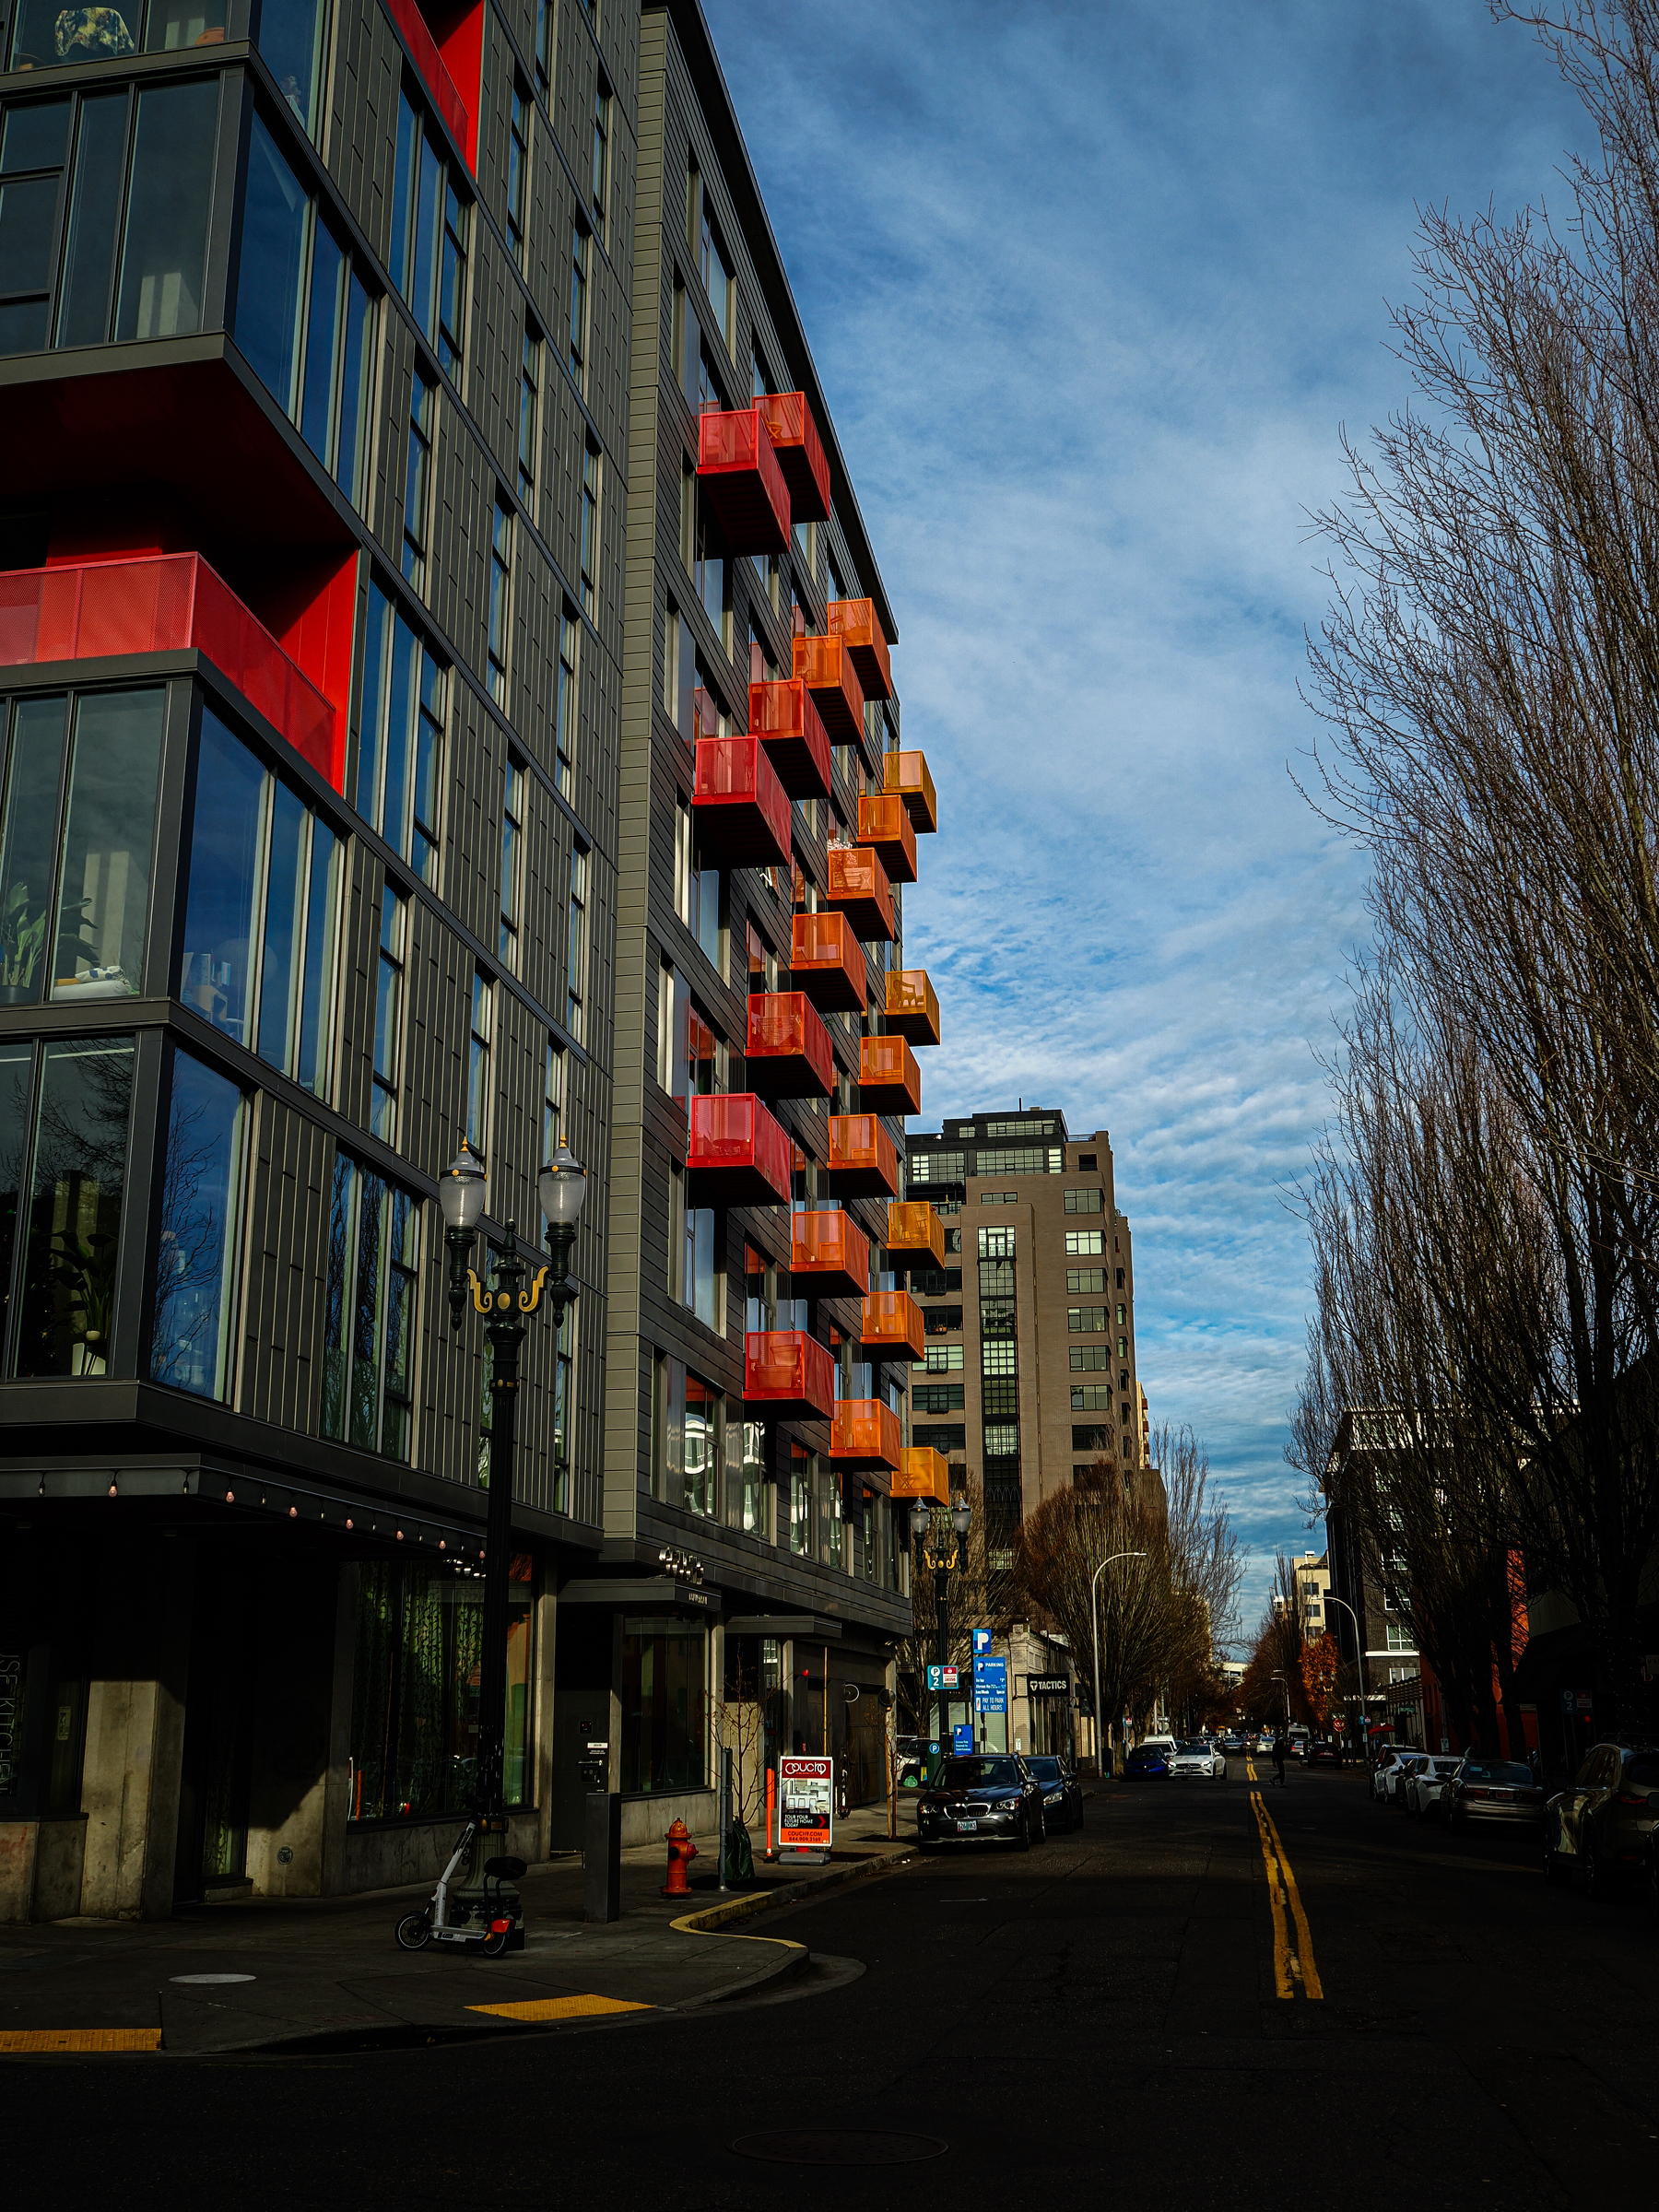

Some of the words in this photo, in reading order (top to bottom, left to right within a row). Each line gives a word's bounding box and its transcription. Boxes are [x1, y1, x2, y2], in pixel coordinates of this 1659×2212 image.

[977, 1633, 989, 1650] P
[933, 1677, 939, 1686] 2
[1038, 1680, 1067, 1690] TACTICS
[1566, 1701, 1573, 1711] 2
